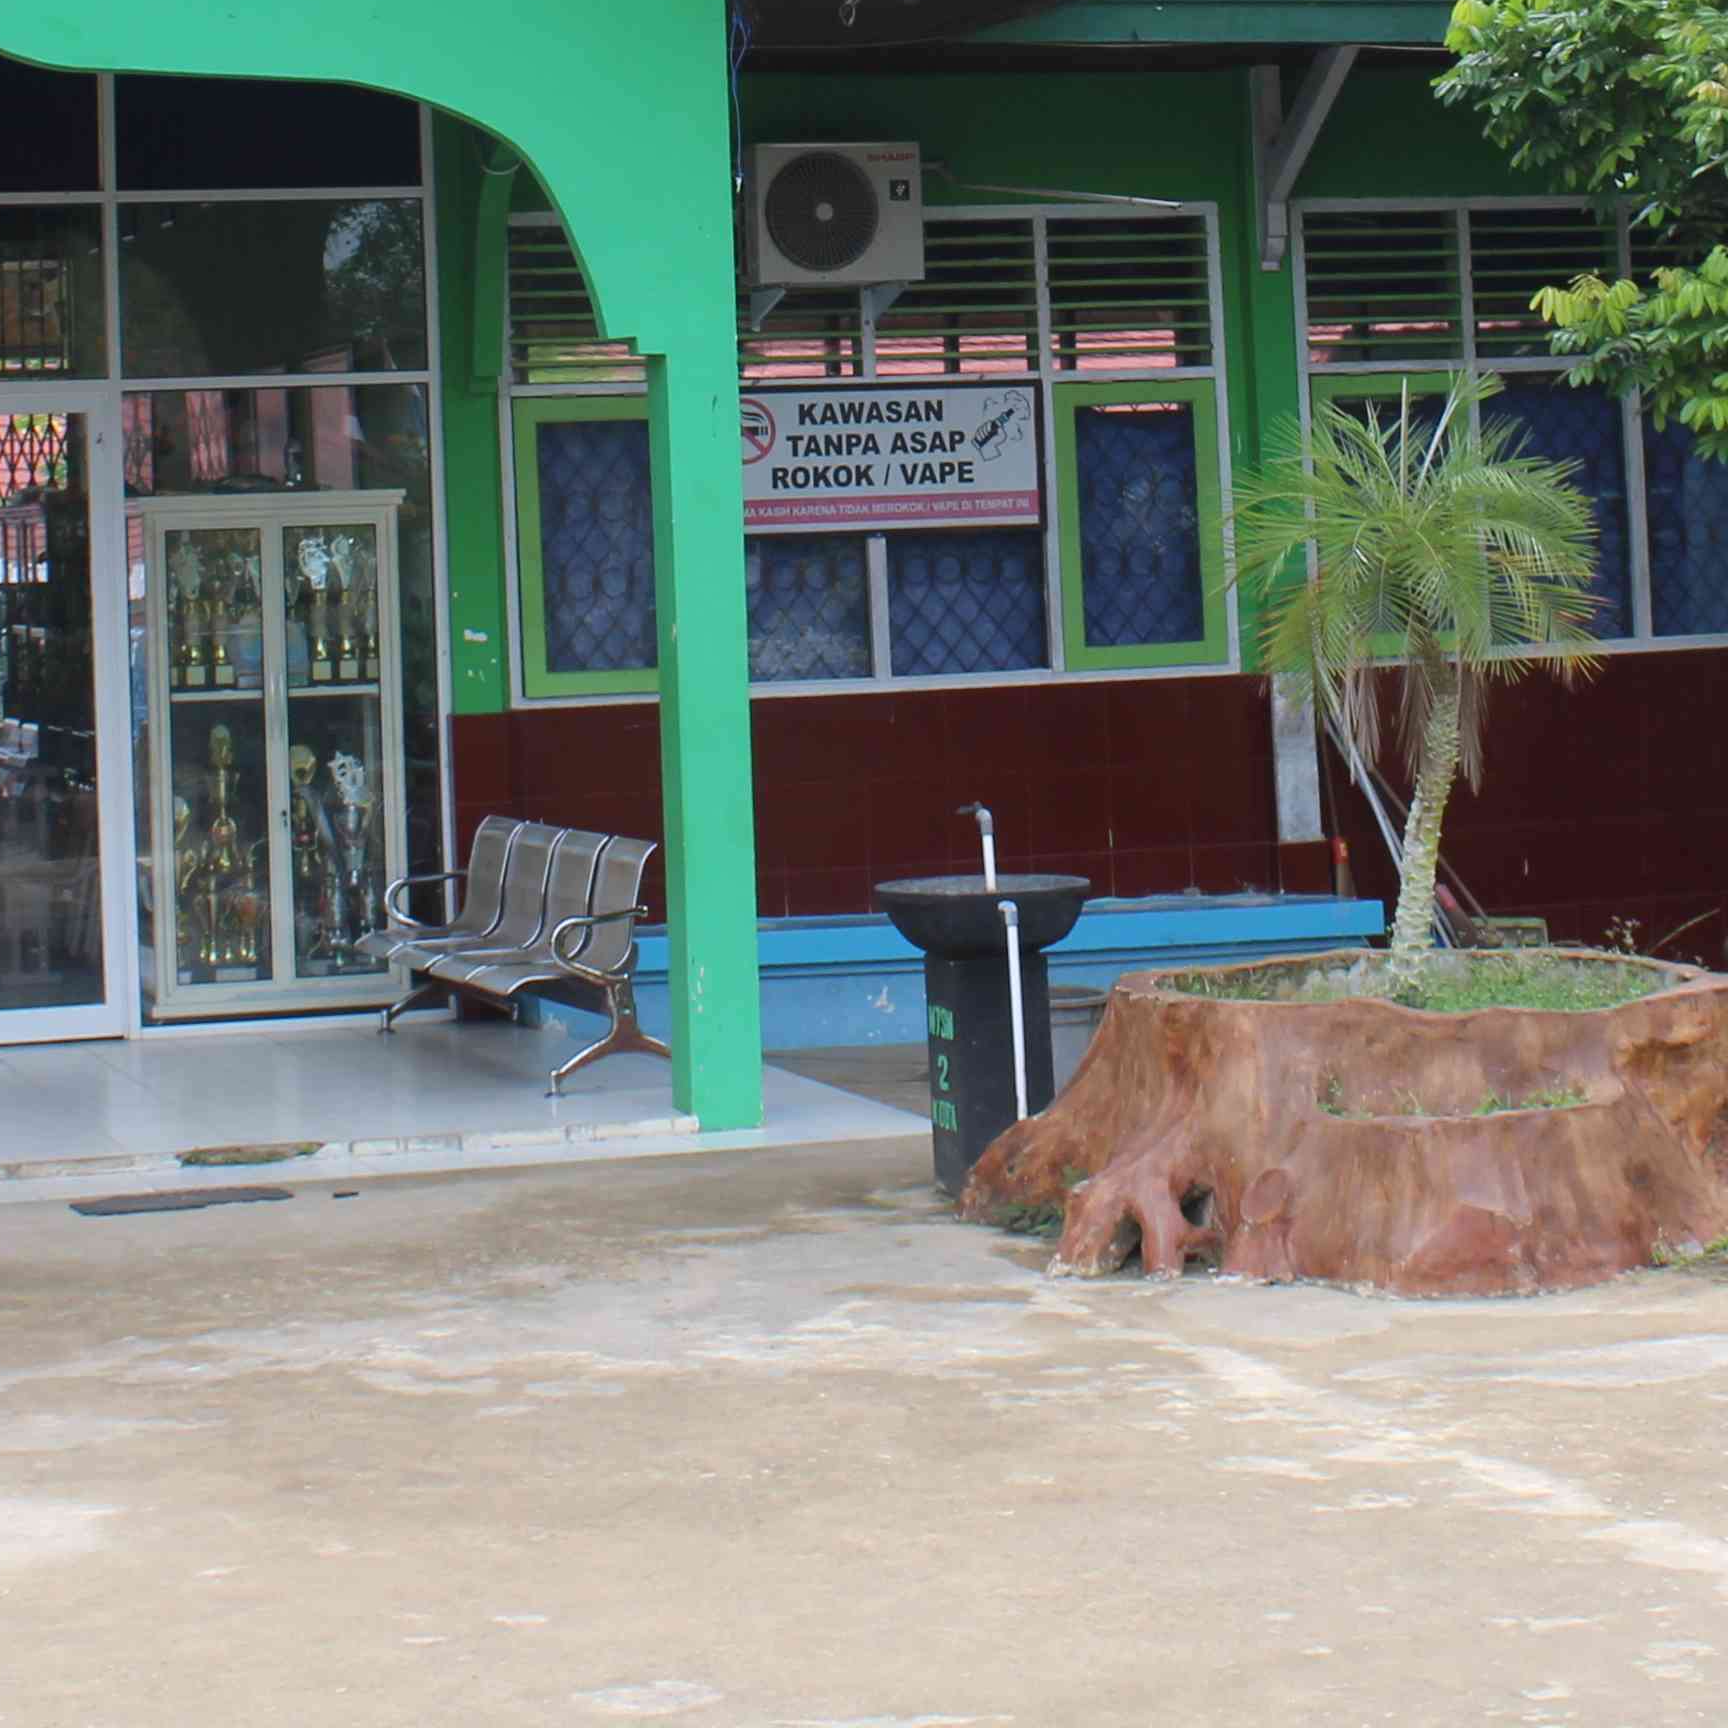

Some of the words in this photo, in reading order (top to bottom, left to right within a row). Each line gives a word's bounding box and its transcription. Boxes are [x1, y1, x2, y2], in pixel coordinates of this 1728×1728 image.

[797, 399, 944, 426] KAWASAN
[785, 433, 880, 458] TANPA
[889, 430, 966, 455] ASAP
[771, 464, 875, 490] ROKOK
[899, 461, 976, 486] VAPE
[936, 1054, 950, 1092] 2
